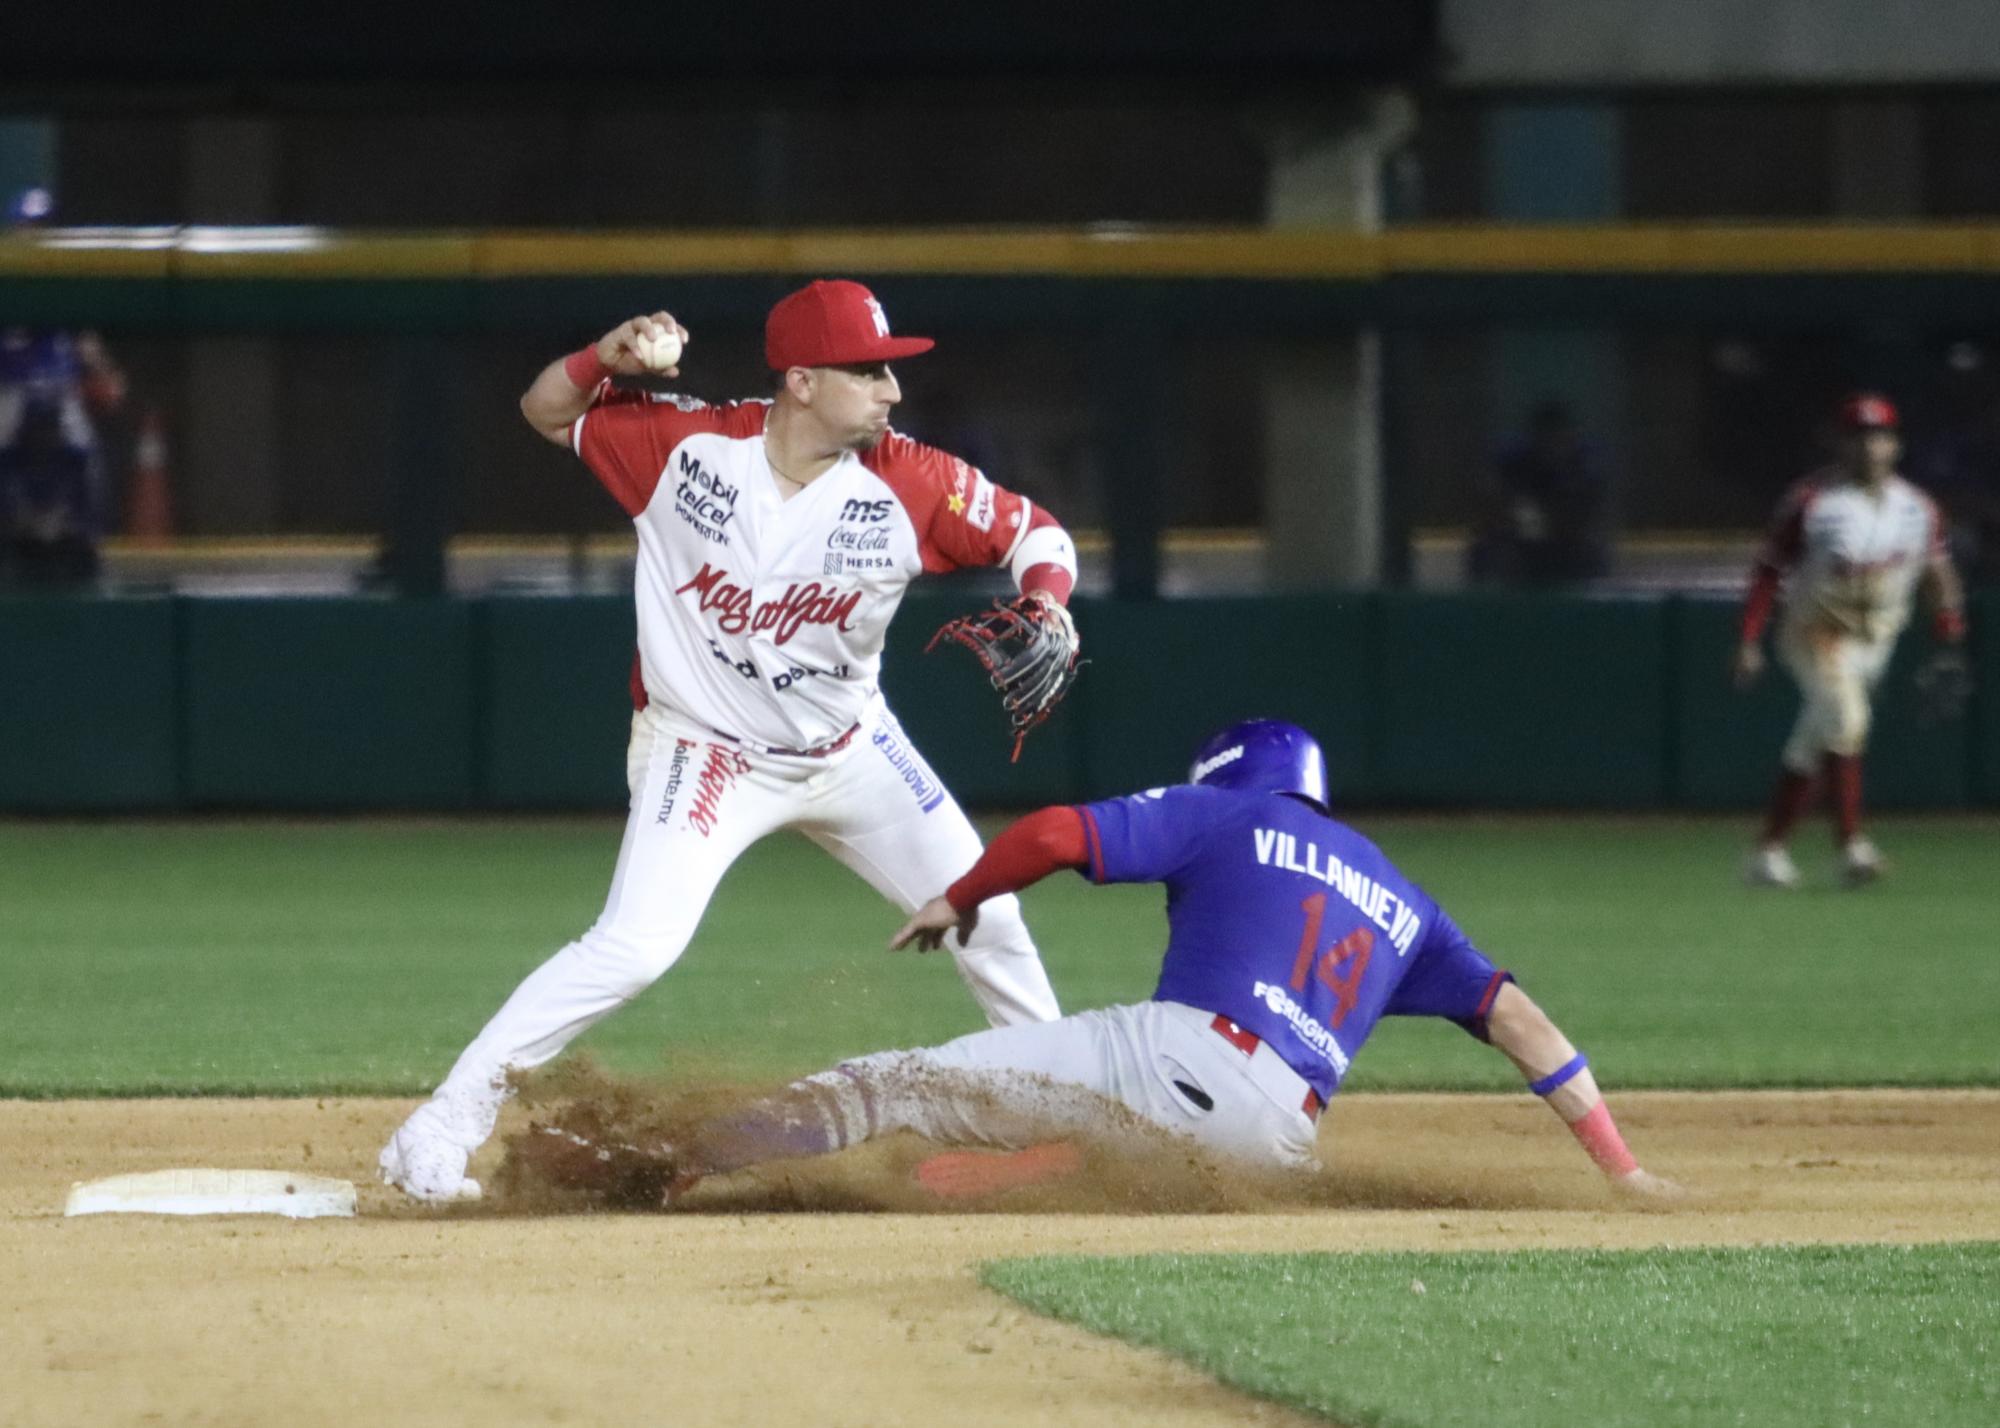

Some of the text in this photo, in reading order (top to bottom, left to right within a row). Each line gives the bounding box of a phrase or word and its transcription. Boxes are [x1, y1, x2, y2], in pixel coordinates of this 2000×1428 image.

[680, 449, 739, 507] Mobil
[676, 481, 734, 528] telcel
[840, 498, 894, 523] ms
[846, 556, 894, 568] HERSA
[1253, 828, 1421, 957] VILLANUEVA
[1288, 891, 1375, 1031] 14
